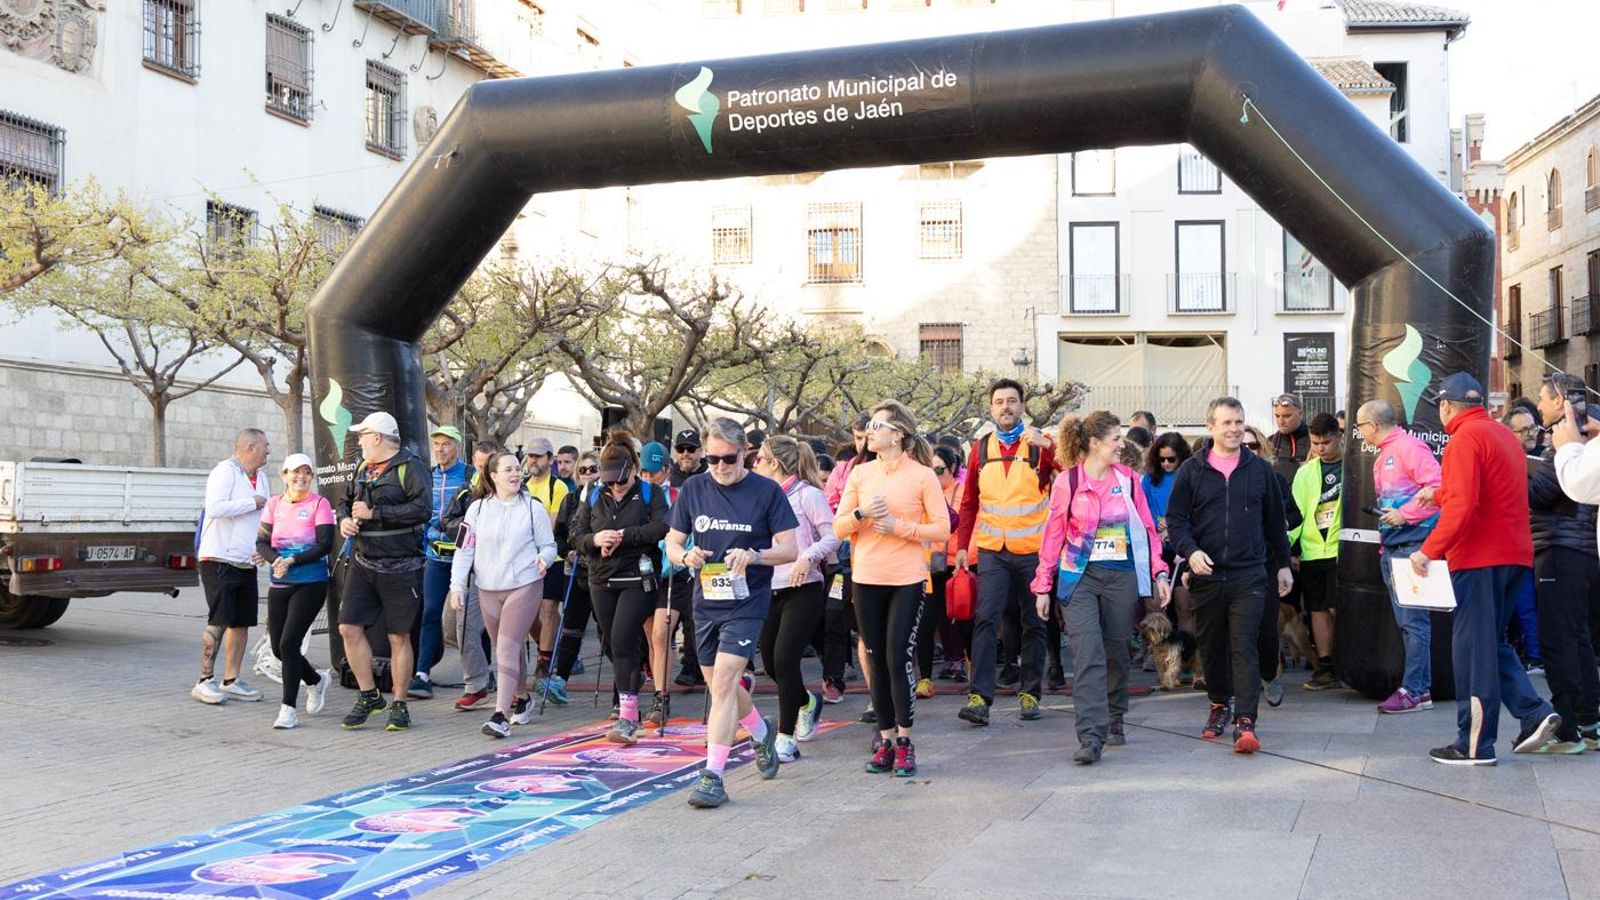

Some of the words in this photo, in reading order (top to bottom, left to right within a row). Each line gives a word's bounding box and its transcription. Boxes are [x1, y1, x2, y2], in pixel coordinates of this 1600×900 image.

[727, 83, 821, 108] Patronato
[827, 74, 925, 99] Municipal
[931, 69, 957, 88] de
[728, 108, 818, 133] Deportes
[823, 104, 849, 123] de
[854, 98, 904, 120] Jaén
[1403, 429, 1450, 444] Municip
[710, 519, 752, 532] Avanza
[1095, 540, 1115, 550] 774
[711, 577, 732, 588] 833
